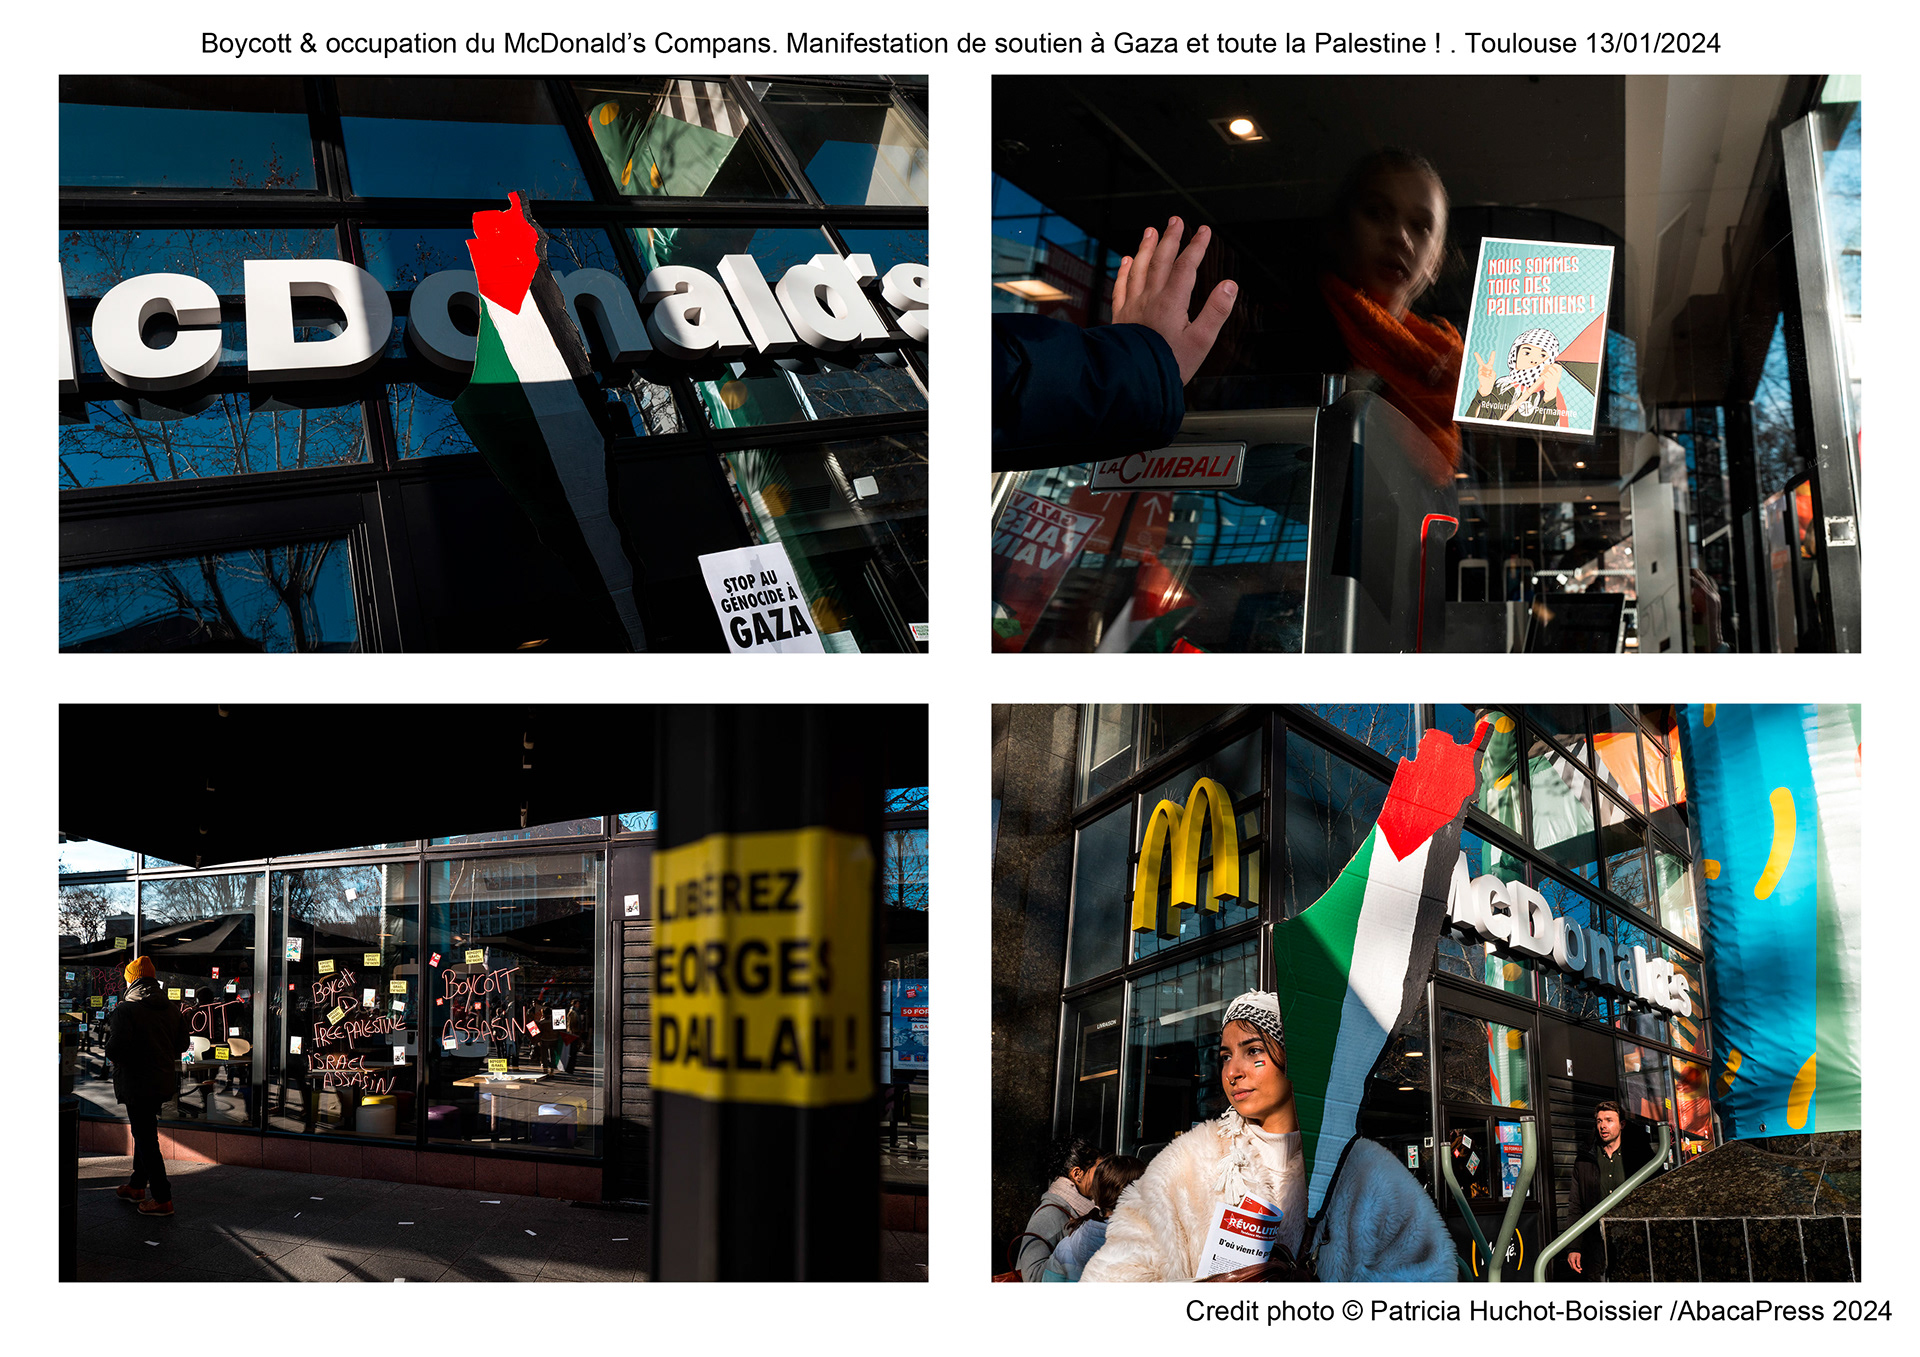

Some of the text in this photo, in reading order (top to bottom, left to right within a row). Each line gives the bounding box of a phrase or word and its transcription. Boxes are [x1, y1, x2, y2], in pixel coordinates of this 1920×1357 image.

[1487, 255, 1580, 276] NOUS SOMMES
[1487, 275, 1551, 296] TOUS DES
[1118, 452, 1235, 484] CIMBALI
[723, 570, 778, 594] STOP AU
[721, 581, 799, 614] GÉNOCIDE À
[729, 604, 812, 648] GAZA
[313, 1022, 345, 1048] FREE
[344, 1015, 407, 1049] PALESTINE
[323, 1071, 396, 1095] ASSASIN
[1219, 1238, 1235, 1249] D'où
[1236, 1245, 1255, 1255] vient
[1256, 1249, 1263, 1257] le
